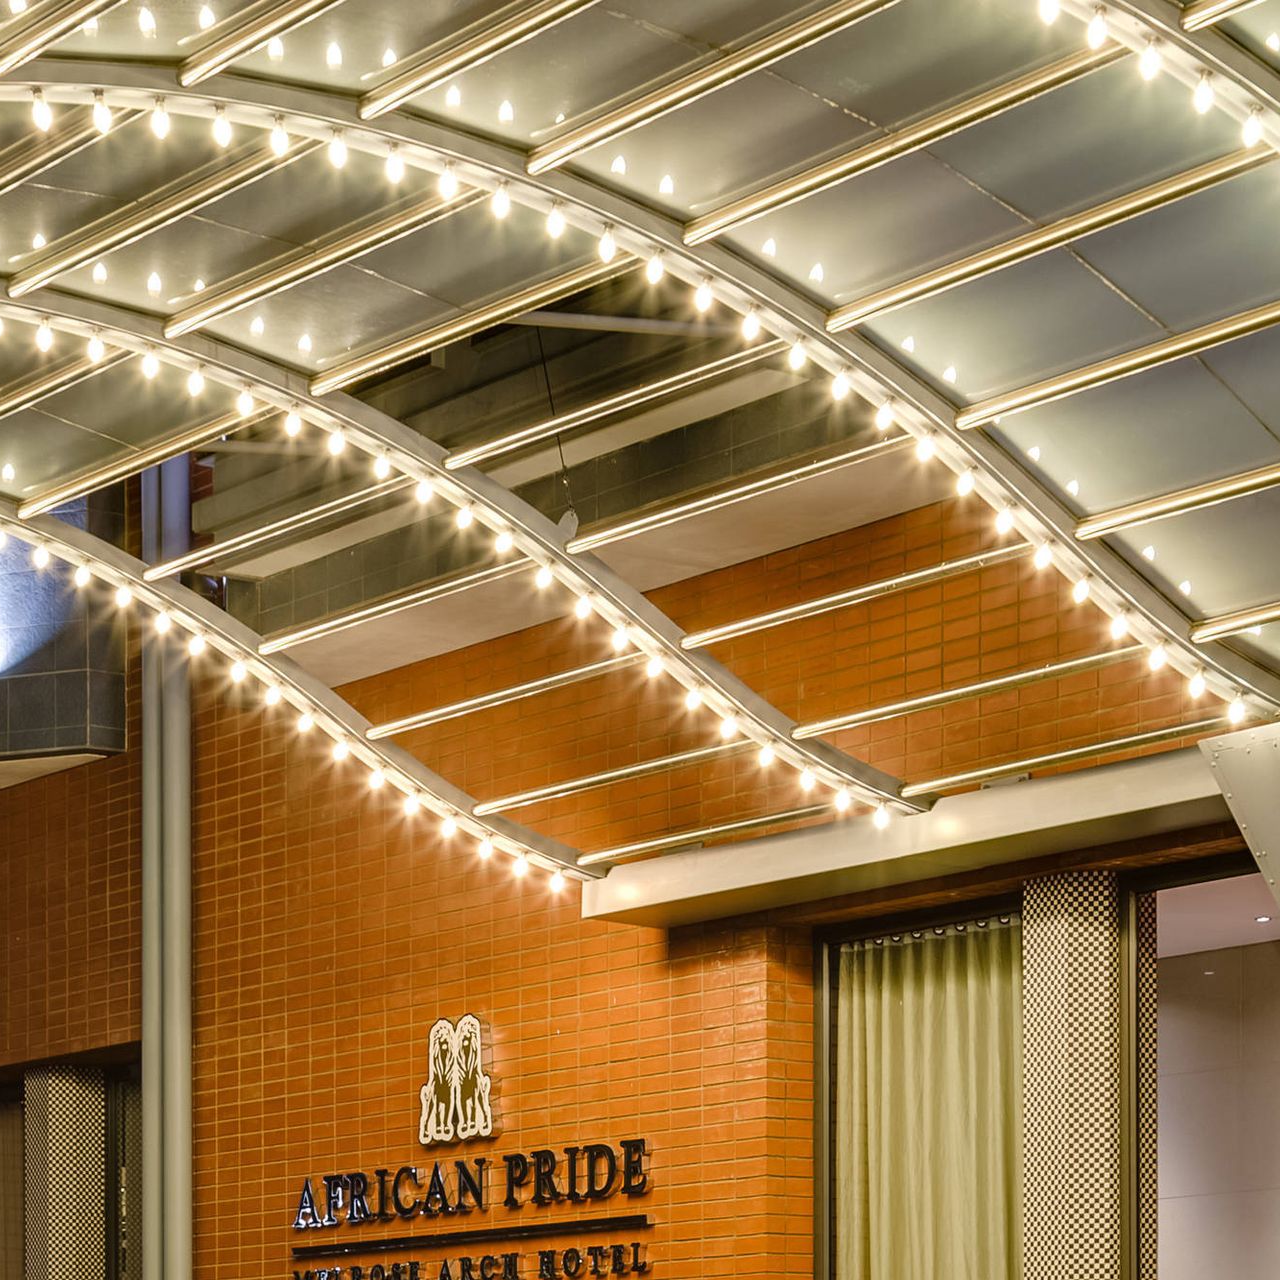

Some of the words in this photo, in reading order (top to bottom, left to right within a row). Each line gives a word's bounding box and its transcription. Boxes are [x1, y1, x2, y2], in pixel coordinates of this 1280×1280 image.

[292, 1158, 487, 1230] AFRICAN
[503, 1138, 648, 1208] PRIDE
[538, 1242, 647, 1280] HOTEL
